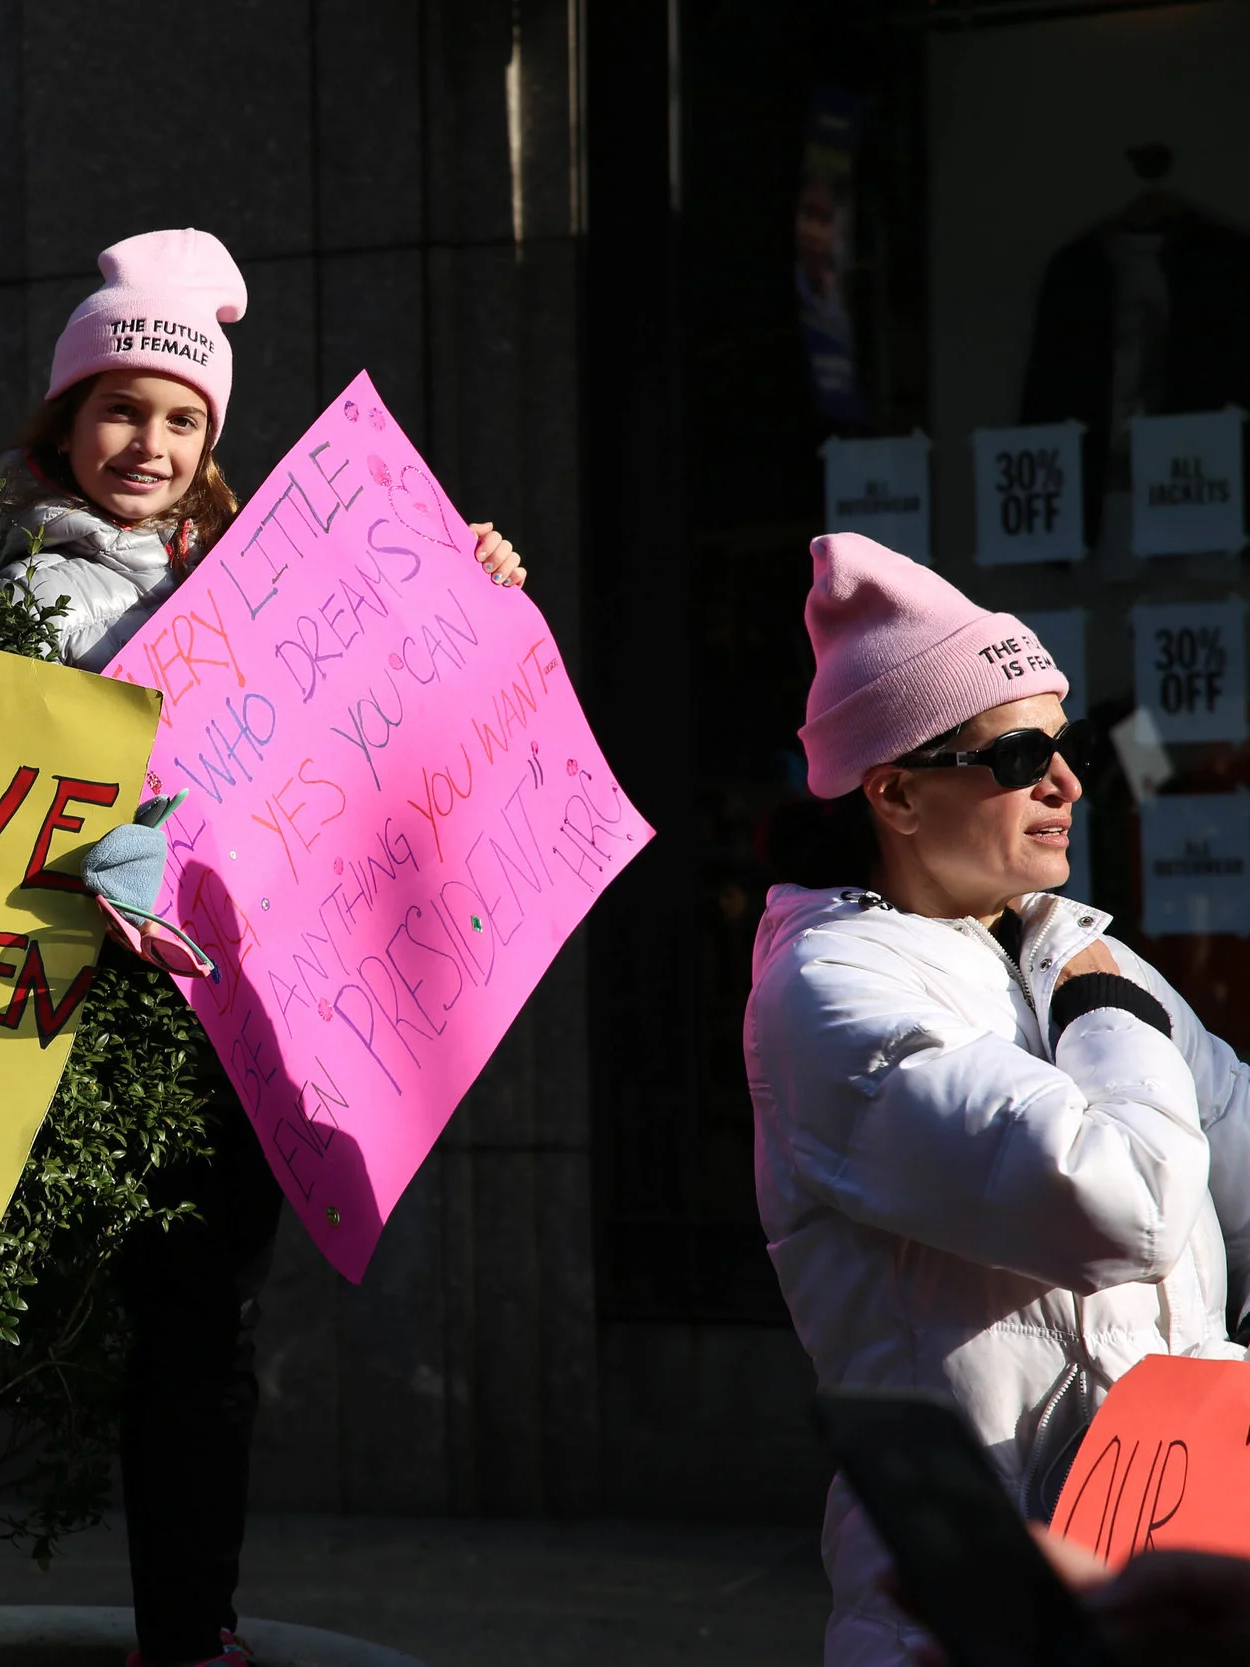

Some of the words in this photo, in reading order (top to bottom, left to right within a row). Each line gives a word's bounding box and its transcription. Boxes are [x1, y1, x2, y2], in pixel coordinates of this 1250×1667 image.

[111, 318, 146, 335] THE
[153, 320, 215, 354] FUTURE
[116, 337, 133, 353] IS
[141, 336, 209, 367] FEMALE
[995, 449, 1066, 494] 30%
[1170, 456, 1205, 479] ALL
[1000, 492, 1063, 536] OFF
[112, 588, 246, 729] VERY
[219, 441, 364, 621] LITTLE
[175, 693, 276, 804] WHO
[276, 518, 421, 703] DREAMS
[978, 638, 1022, 665] THE
[1001, 660, 1025, 681] IS
[1155, 628, 1226, 671] 30%
[1160, 672, 1224, 715] OFF
[252, 758, 346, 886] YES
[330, 669, 404, 791] YOU
[402, 588, 479, 684] CAN
[408, 744, 474, 863] YOU
[273, 1055, 350, 1202] EVEN
